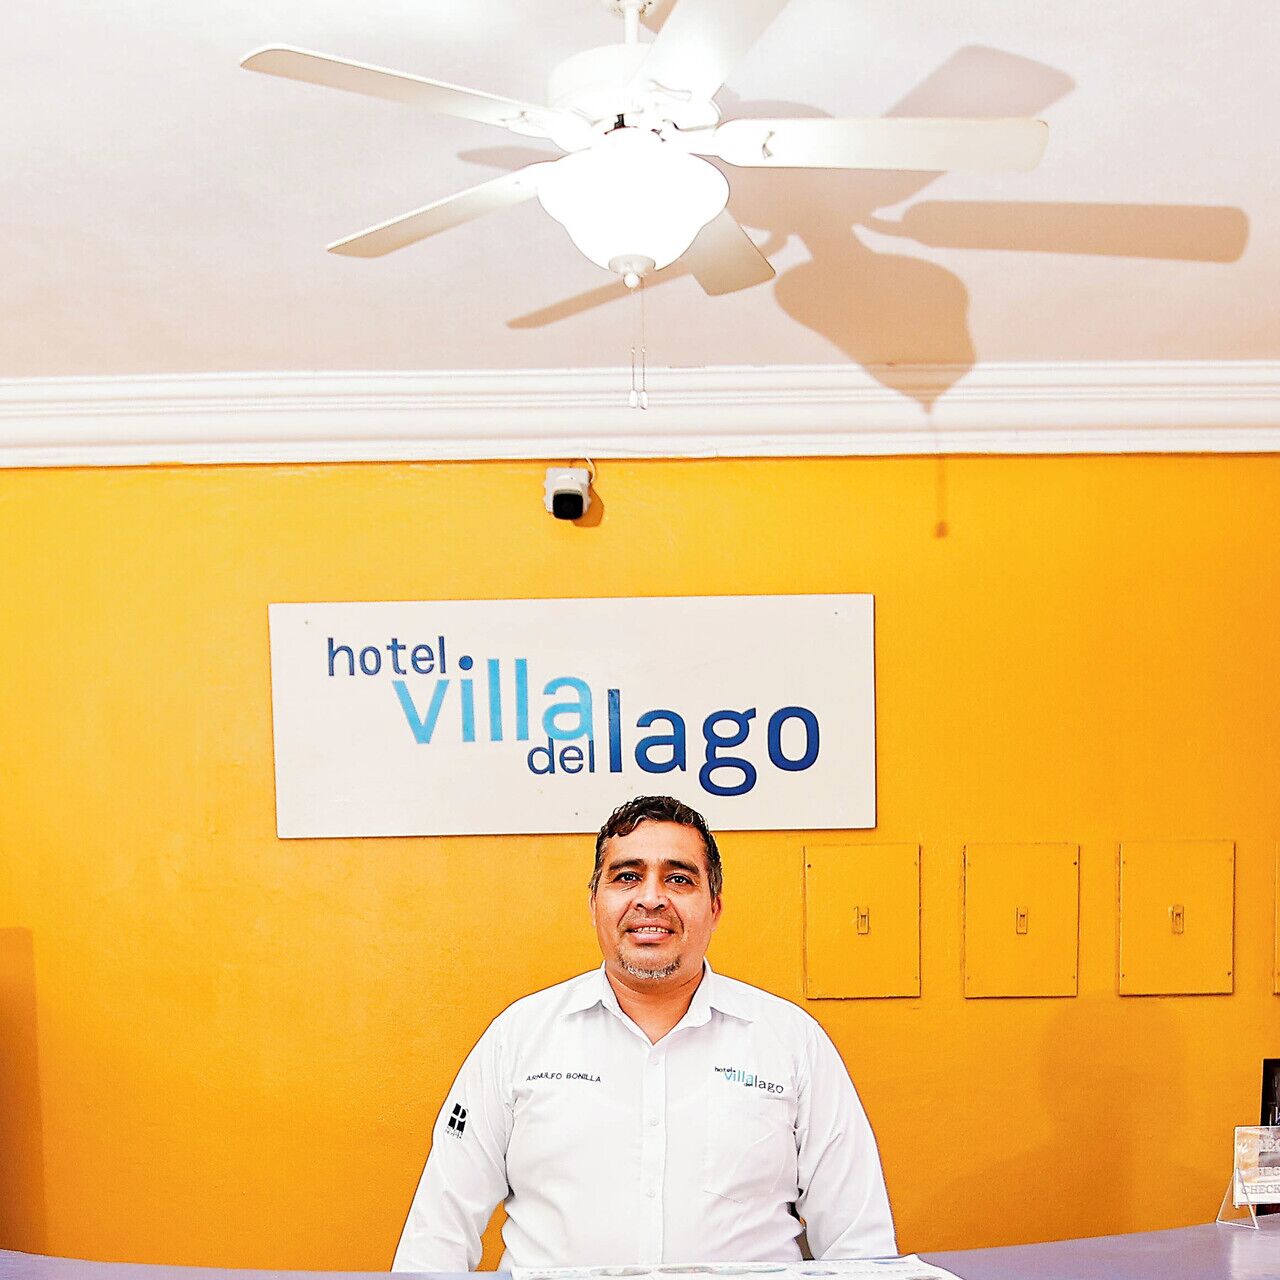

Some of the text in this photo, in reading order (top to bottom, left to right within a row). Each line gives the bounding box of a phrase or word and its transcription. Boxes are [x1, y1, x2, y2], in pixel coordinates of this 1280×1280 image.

[327, 636, 446, 676] hotel
[391, 656, 593, 744] villa
[527, 689, 820, 796] del lago
[526, 1072, 601, 1083] ARNULFO BONILLA
[724, 1069, 754, 1084] villa
[755, 1075, 784, 1094] lago
